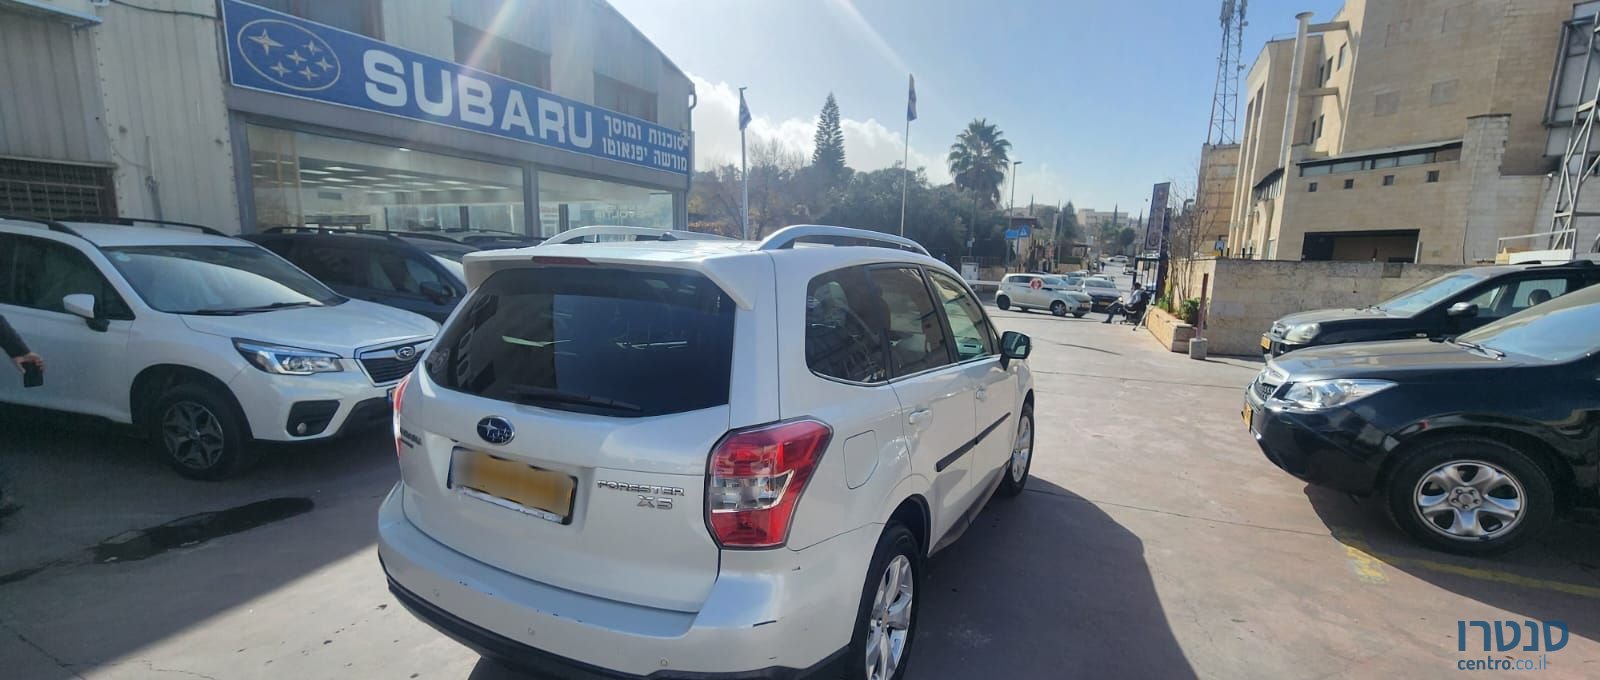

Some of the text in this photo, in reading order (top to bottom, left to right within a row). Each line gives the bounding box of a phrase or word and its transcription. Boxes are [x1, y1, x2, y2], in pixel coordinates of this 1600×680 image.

[363, 49, 593, 148] SUBARU
[604, 115, 642, 140] ומוסך
[653, 149, 688, 171] מורשה
[597, 480, 685, 496] FORESTER
[637, 495, 673, 510] XS
